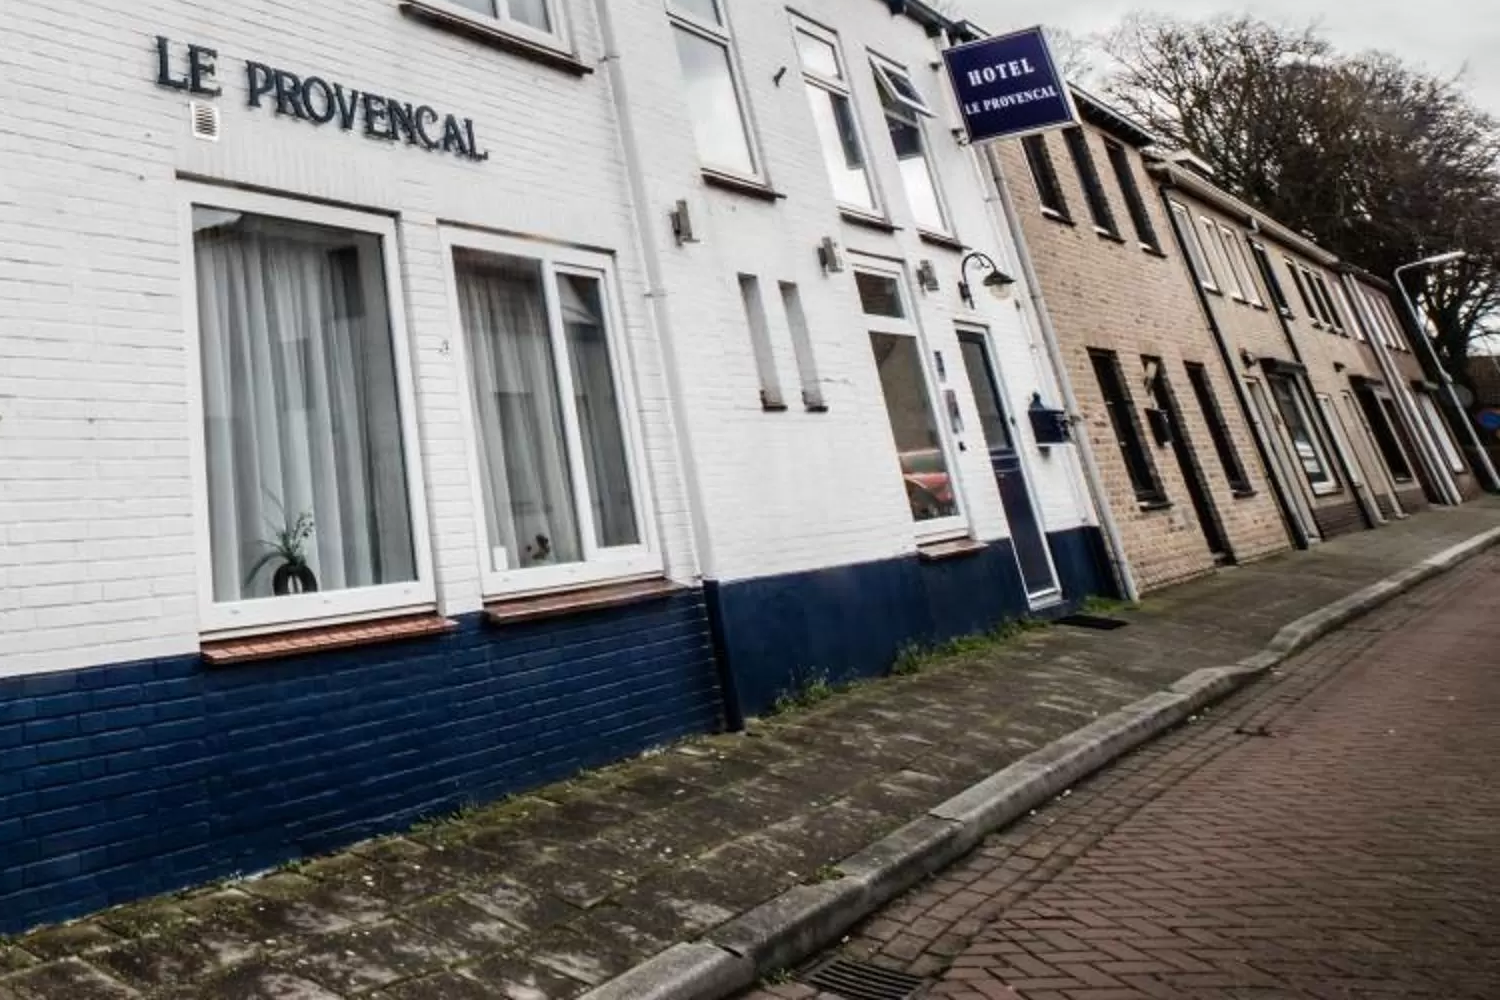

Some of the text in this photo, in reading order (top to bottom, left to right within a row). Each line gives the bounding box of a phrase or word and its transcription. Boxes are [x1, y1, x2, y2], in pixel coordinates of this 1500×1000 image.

[967, 57, 1035, 87] HOTEL
[155, 35, 489, 161] LE PROVENCAL
[965, 84, 1058, 115] LE PROVENCAL
